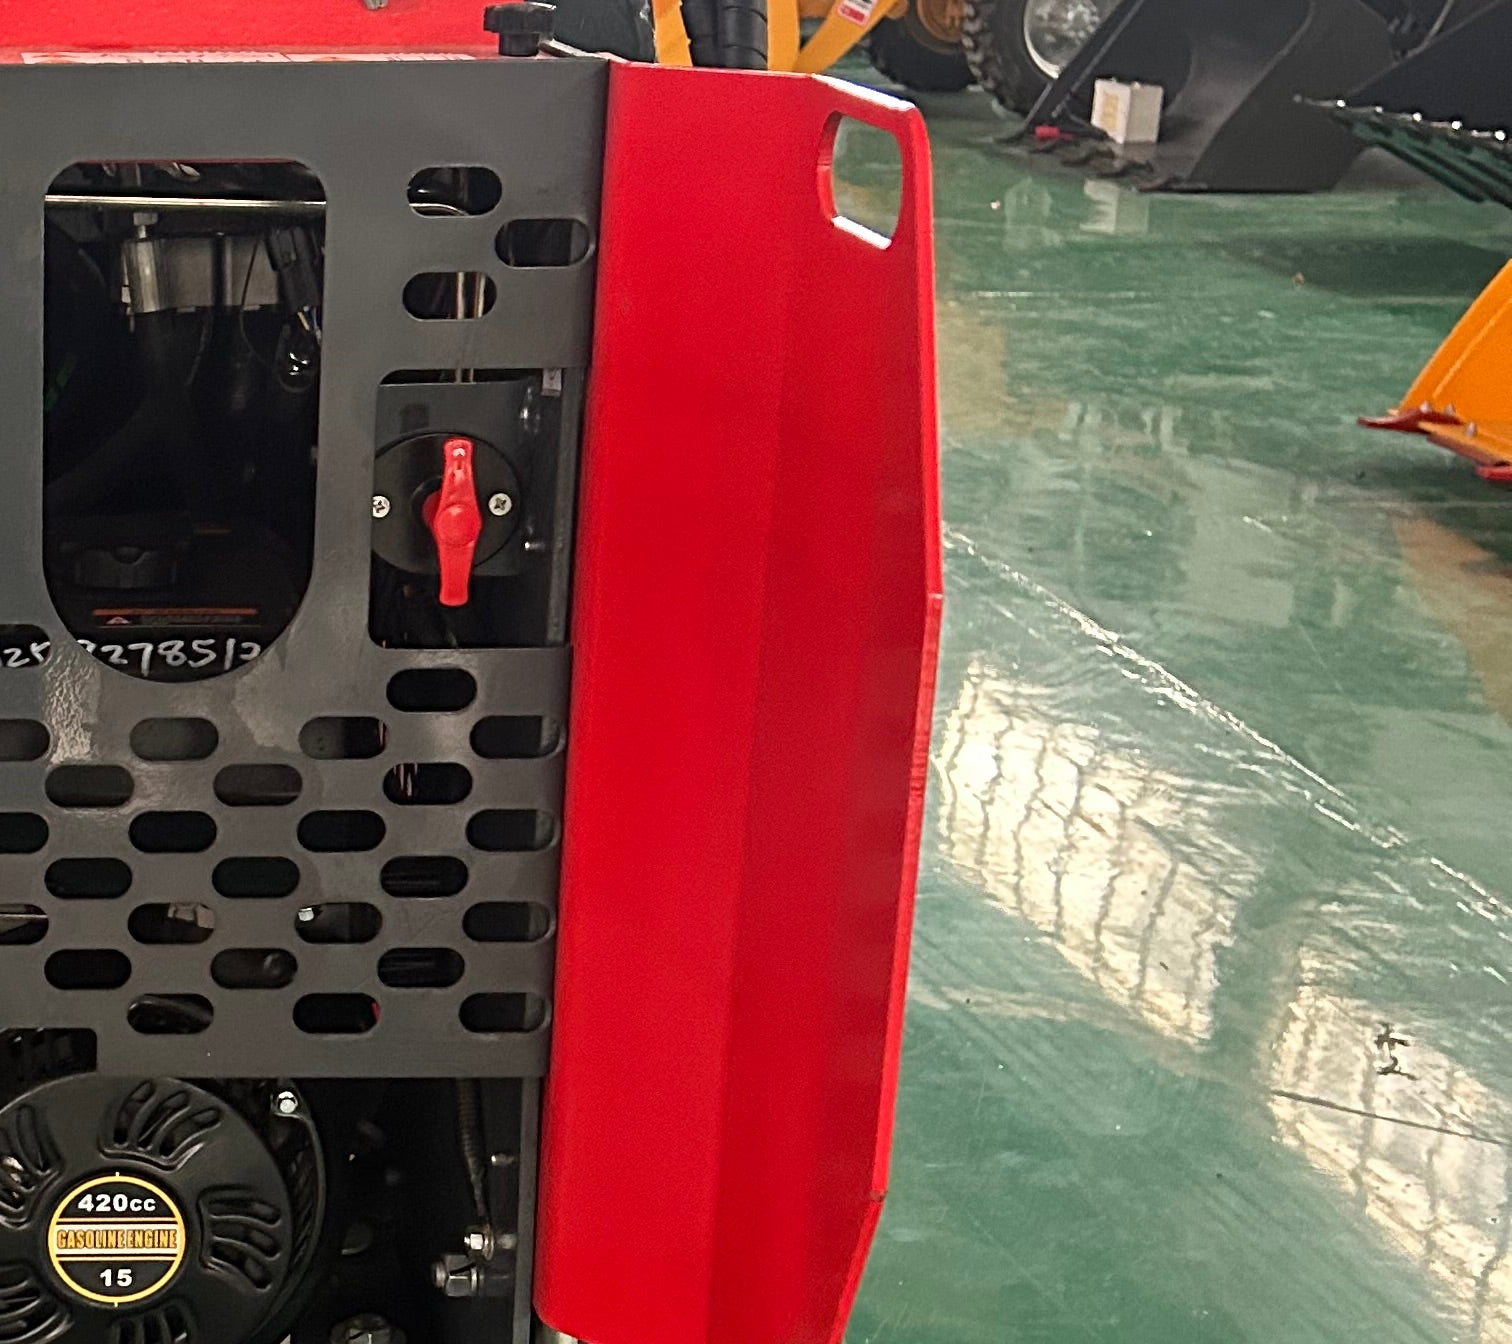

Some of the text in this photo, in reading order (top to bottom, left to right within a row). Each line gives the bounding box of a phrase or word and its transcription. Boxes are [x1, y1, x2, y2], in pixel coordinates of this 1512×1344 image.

[78, 1193, 156, 1212] 420cc
[57, 1229, 177, 1249] GASOLINE ENGINE
[99, 1268, 133, 1287] 15
